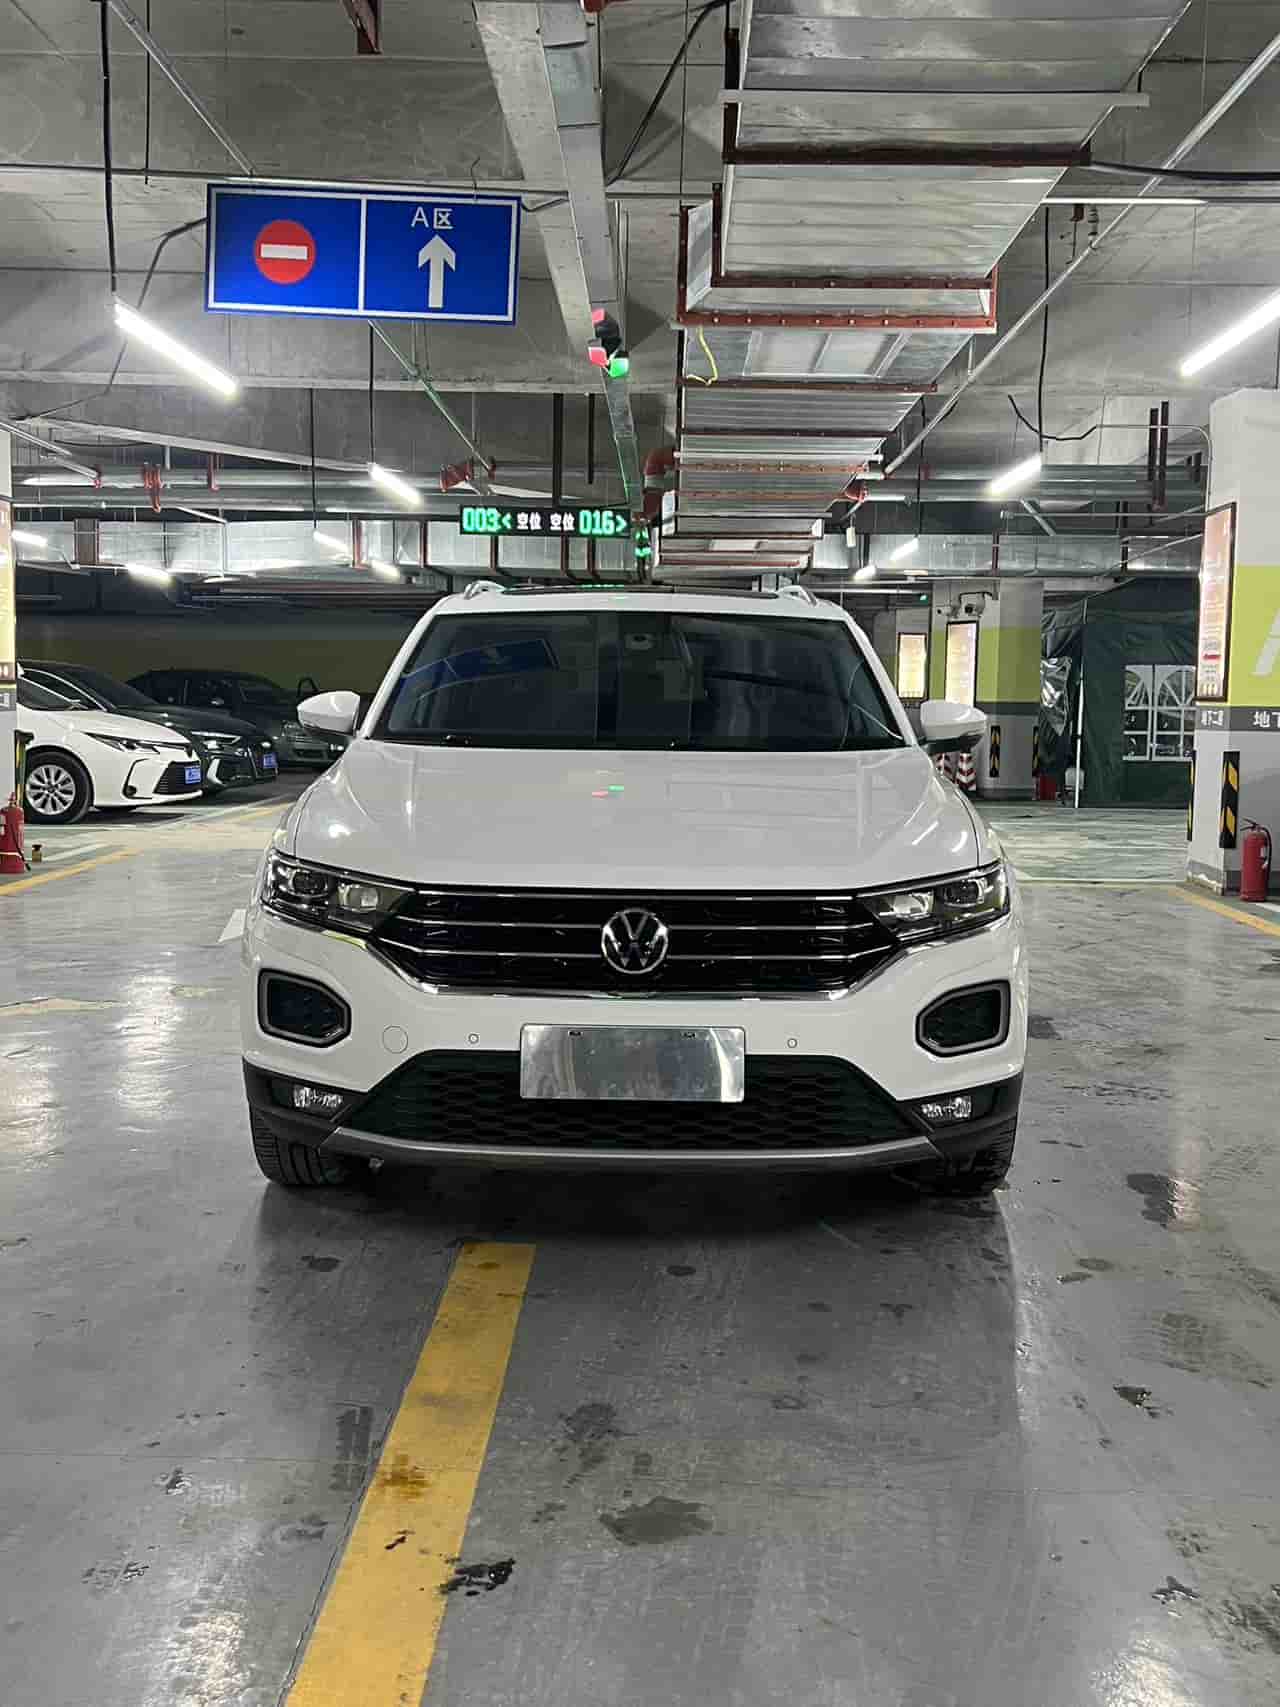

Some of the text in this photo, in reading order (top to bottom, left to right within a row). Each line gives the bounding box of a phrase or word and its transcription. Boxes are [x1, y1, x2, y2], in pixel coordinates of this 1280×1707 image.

[411, 206, 454, 230] A区
[517, 512, 542, 531] 空位
[550, 513, 575, 532] 空位
